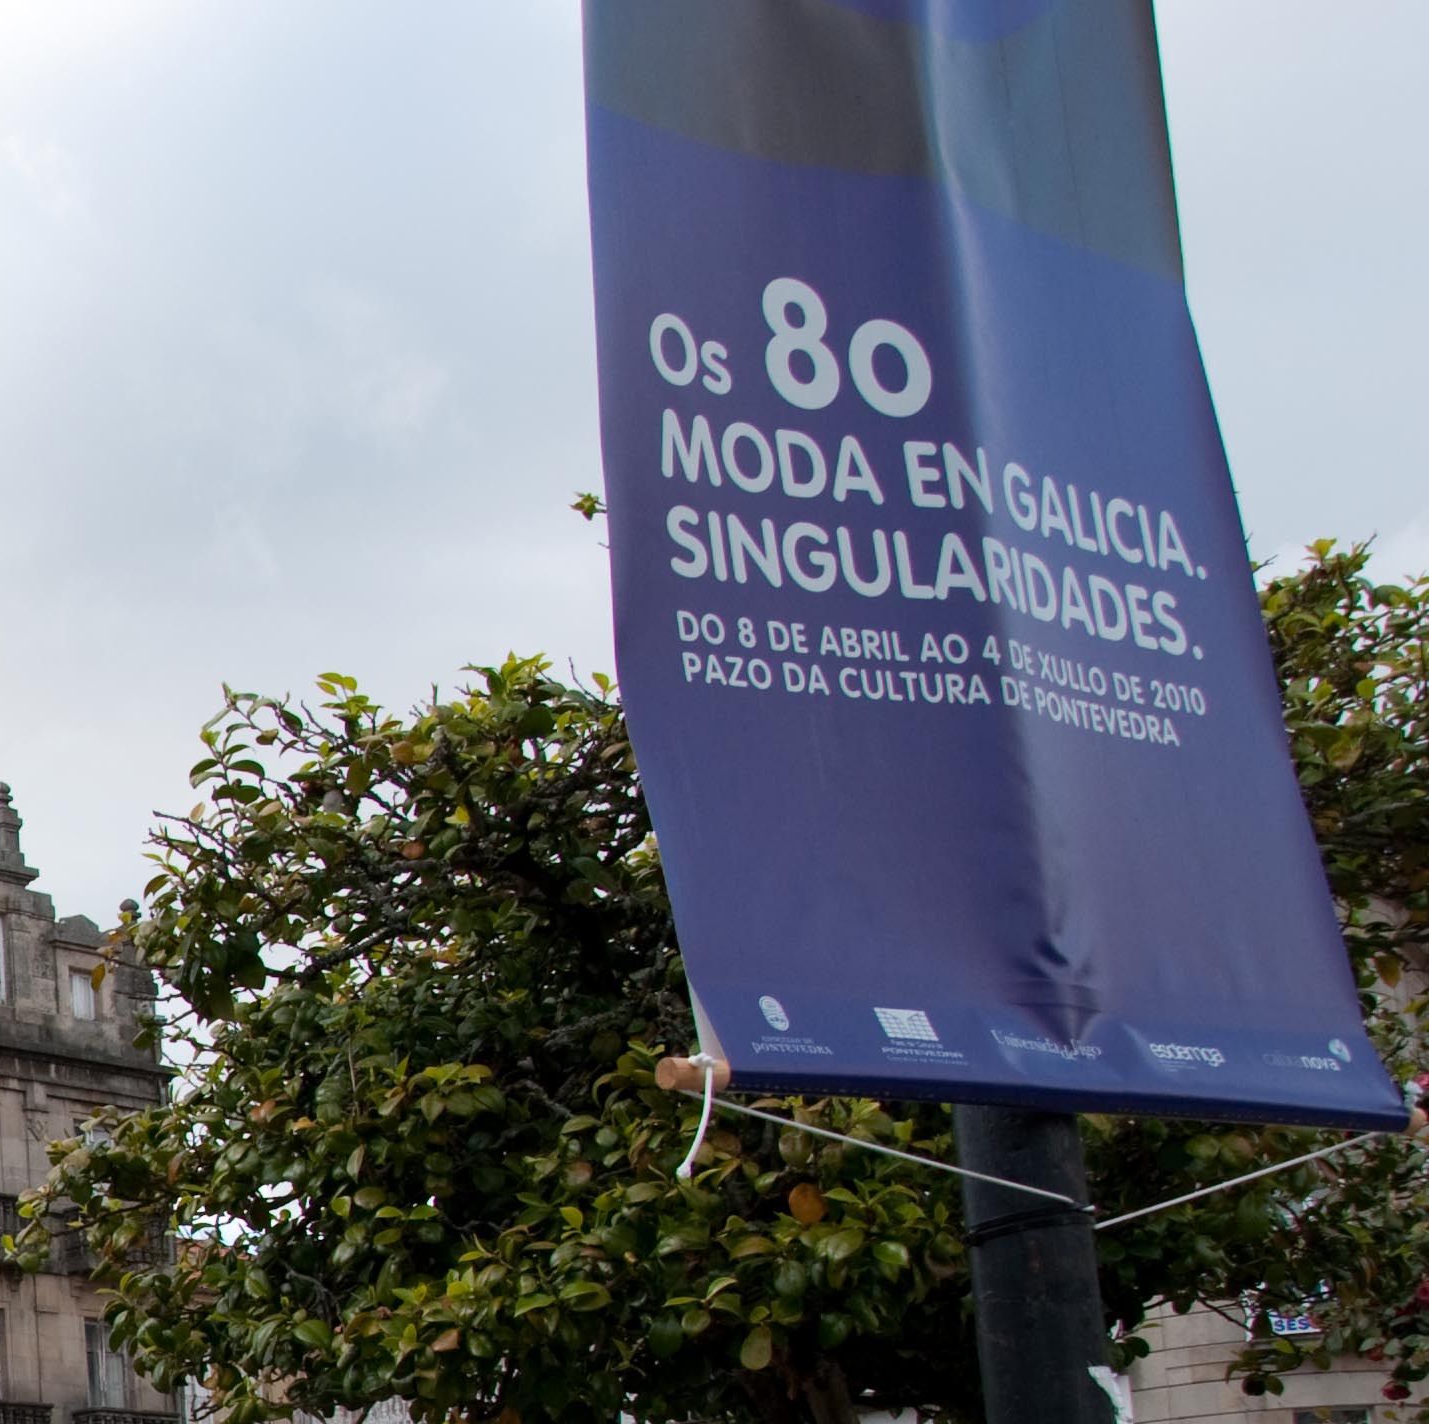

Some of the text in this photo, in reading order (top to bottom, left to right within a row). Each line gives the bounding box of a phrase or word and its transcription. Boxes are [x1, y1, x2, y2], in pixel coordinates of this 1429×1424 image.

[649, 277, 932, 418] Os 80
[661, 408, 1207, 580] MODA EN GALICIA.
[666, 505, 1204, 660] SINGULARIDADES.
[676, 610, 1206, 717] DO 8 DE ABRIL AO 4 DE XULLO DE 2010
[682, 651, 1181, 747] PAZO DA CULTURA DE PONTEVEDRA
